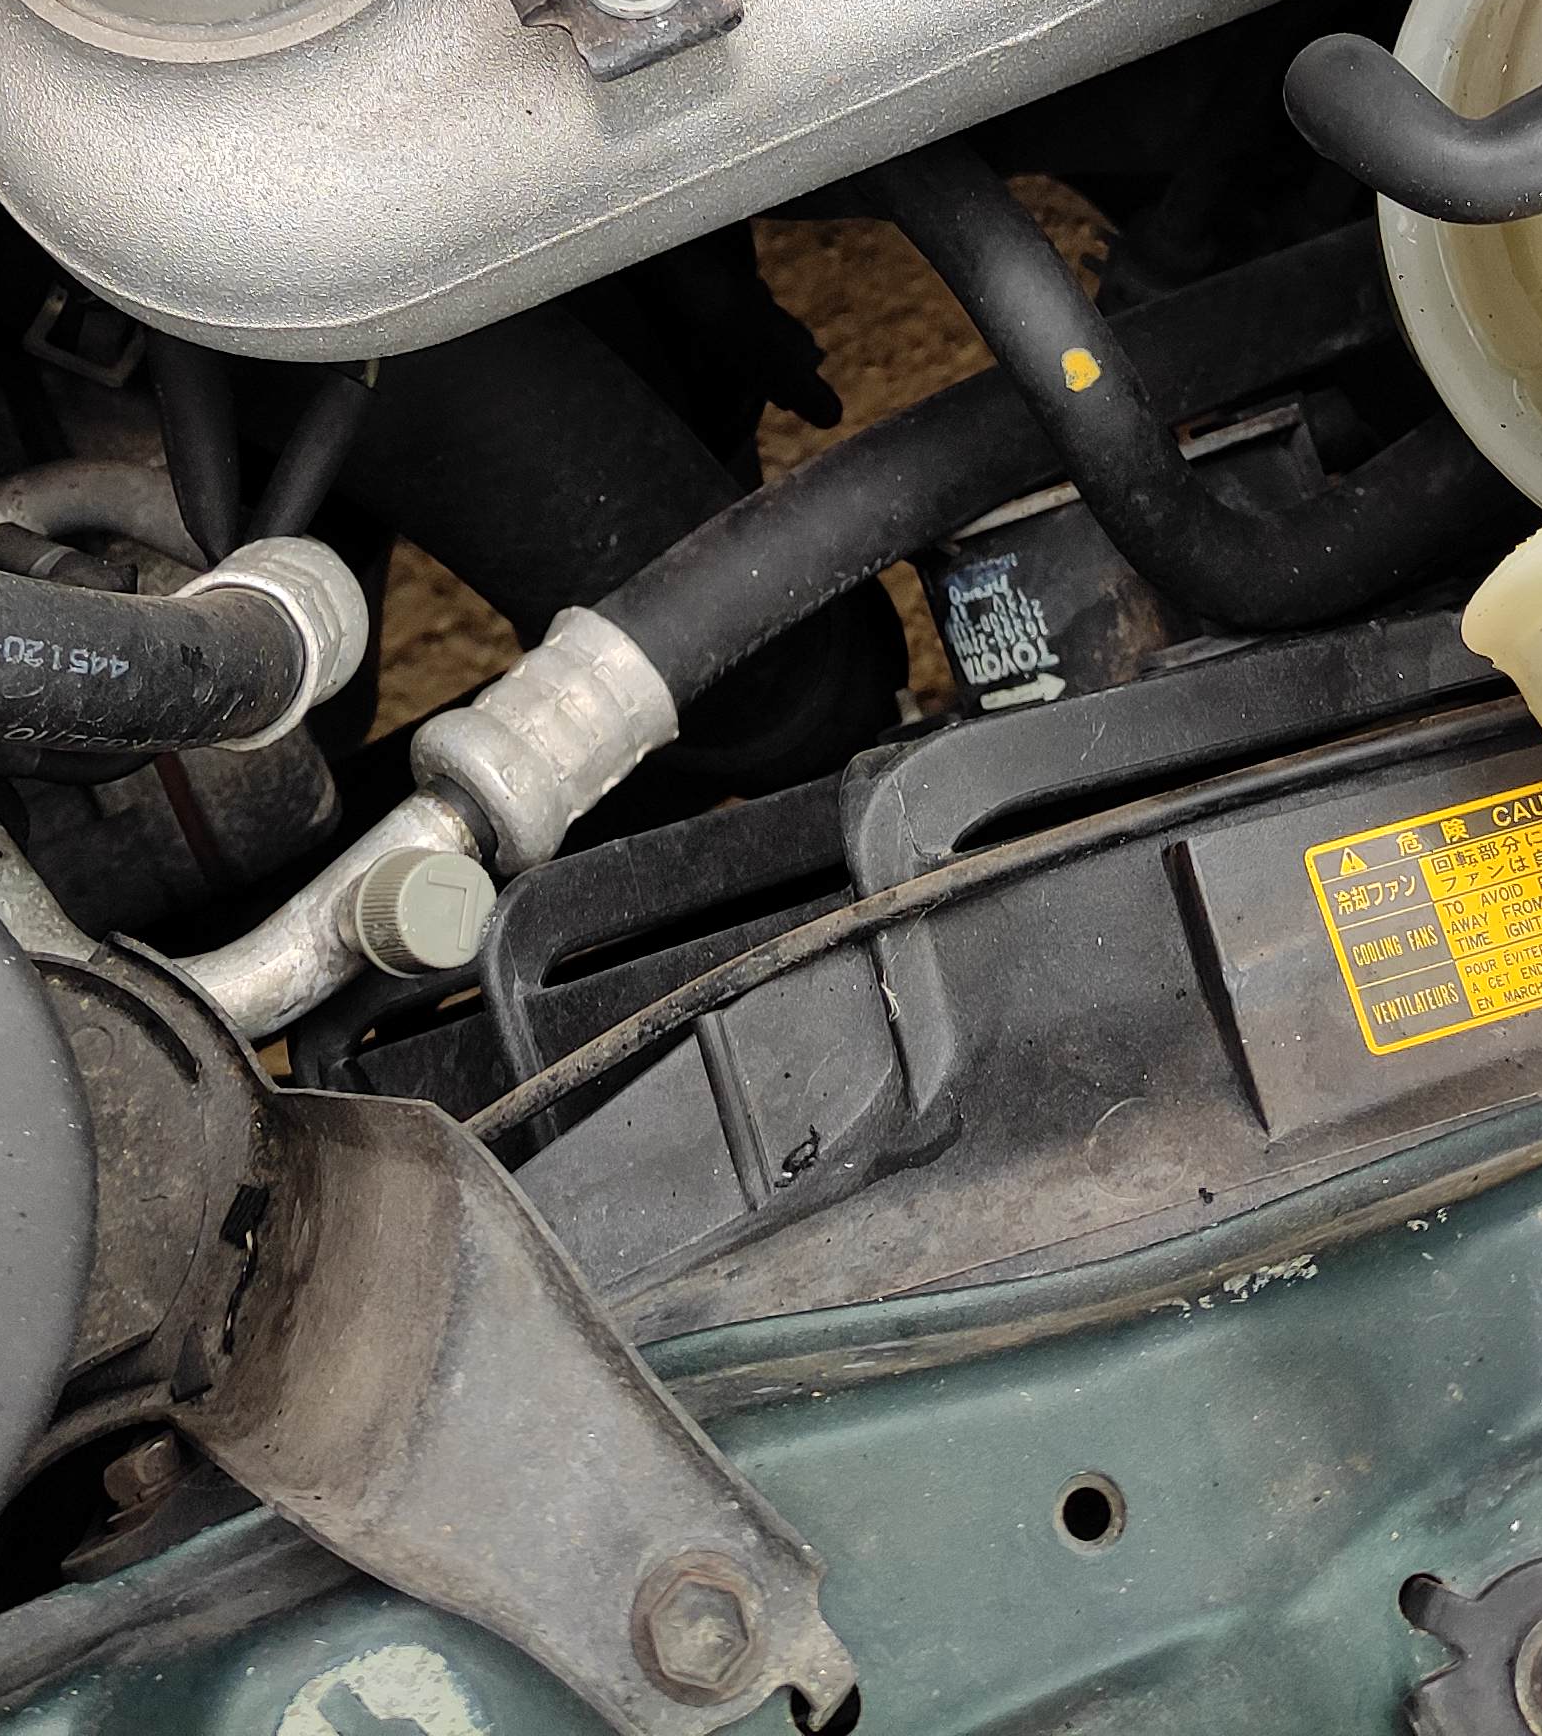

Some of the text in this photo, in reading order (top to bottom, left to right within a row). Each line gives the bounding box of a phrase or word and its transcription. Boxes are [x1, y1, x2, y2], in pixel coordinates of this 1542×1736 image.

[960, 636, 1059, 684] TOYOTA
[1332, 869, 1420, 916] 冷却ファン
[1442, 899, 1465, 919] TO
[1478, 882, 1524, 907] AVOID
[1448, 911, 1491, 935] AWAY
[1351, 923, 1439, 968] COOLING FANS
[1456, 930, 1493, 953] TIME
[1464, 958, 1498, 978] POUR
[1487, 972, 1512, 989] CET
[1371, 981, 1460, 1026] VENTILATEURS
[1476, 996, 1494, 1011] EN
